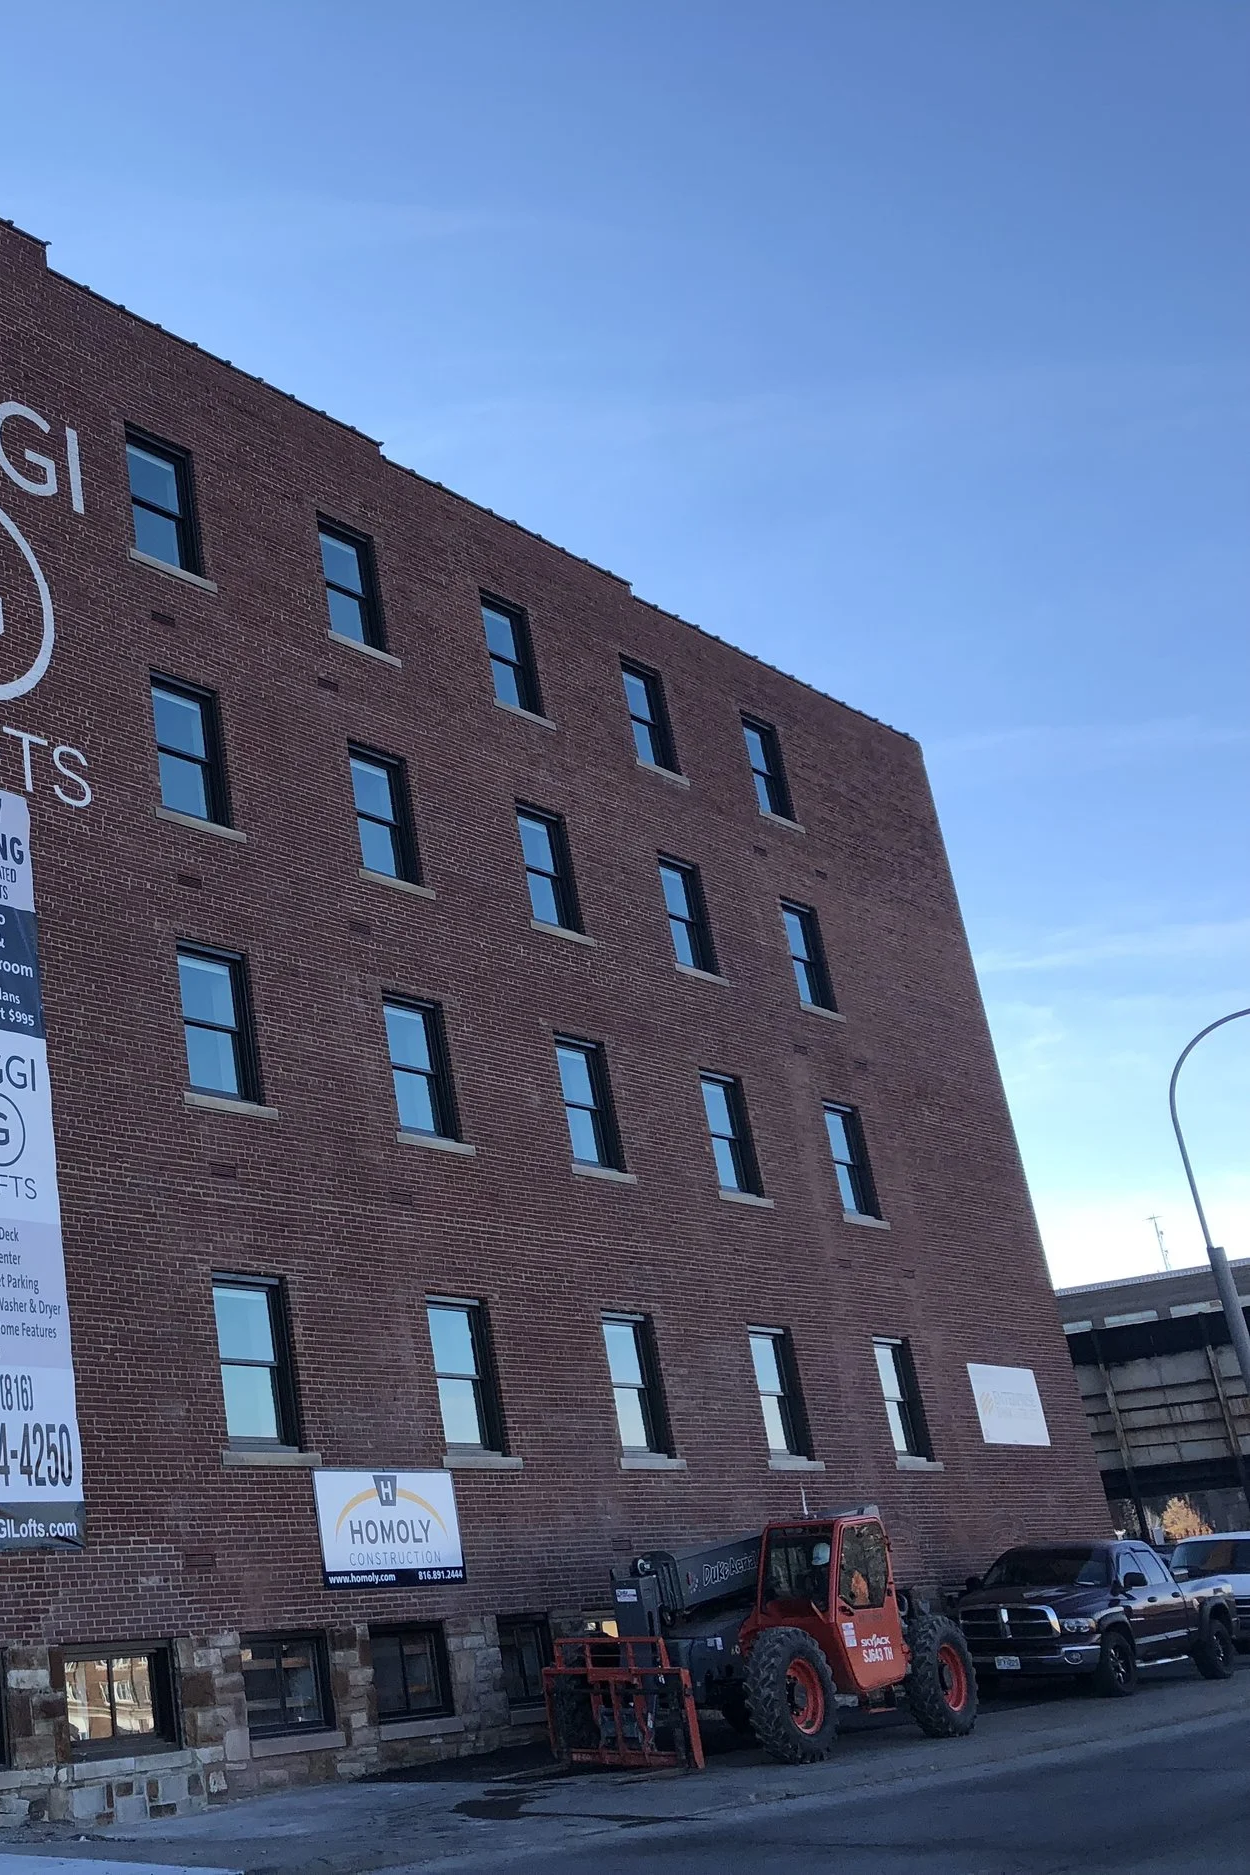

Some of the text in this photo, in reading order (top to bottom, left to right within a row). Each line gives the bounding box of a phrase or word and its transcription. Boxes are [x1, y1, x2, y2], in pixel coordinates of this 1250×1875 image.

[9, 1008, 35, 1027] $995
[7, 1274, 40, 1295] Parking
[29, 1302, 37, 1314] &
[38, 1303, 61, 1320] Dryer
[21, 1323, 57, 1339] Features
[0, 1374, 34, 1412] (816)
[380, 1480, 393, 1500] H
[350, 1519, 431, 1544] HOMOLY
[350, 1550, 441, 1566] CONSTRUCTION
[328, 1569, 463, 1585] www.homoly.com 816.891.2444
